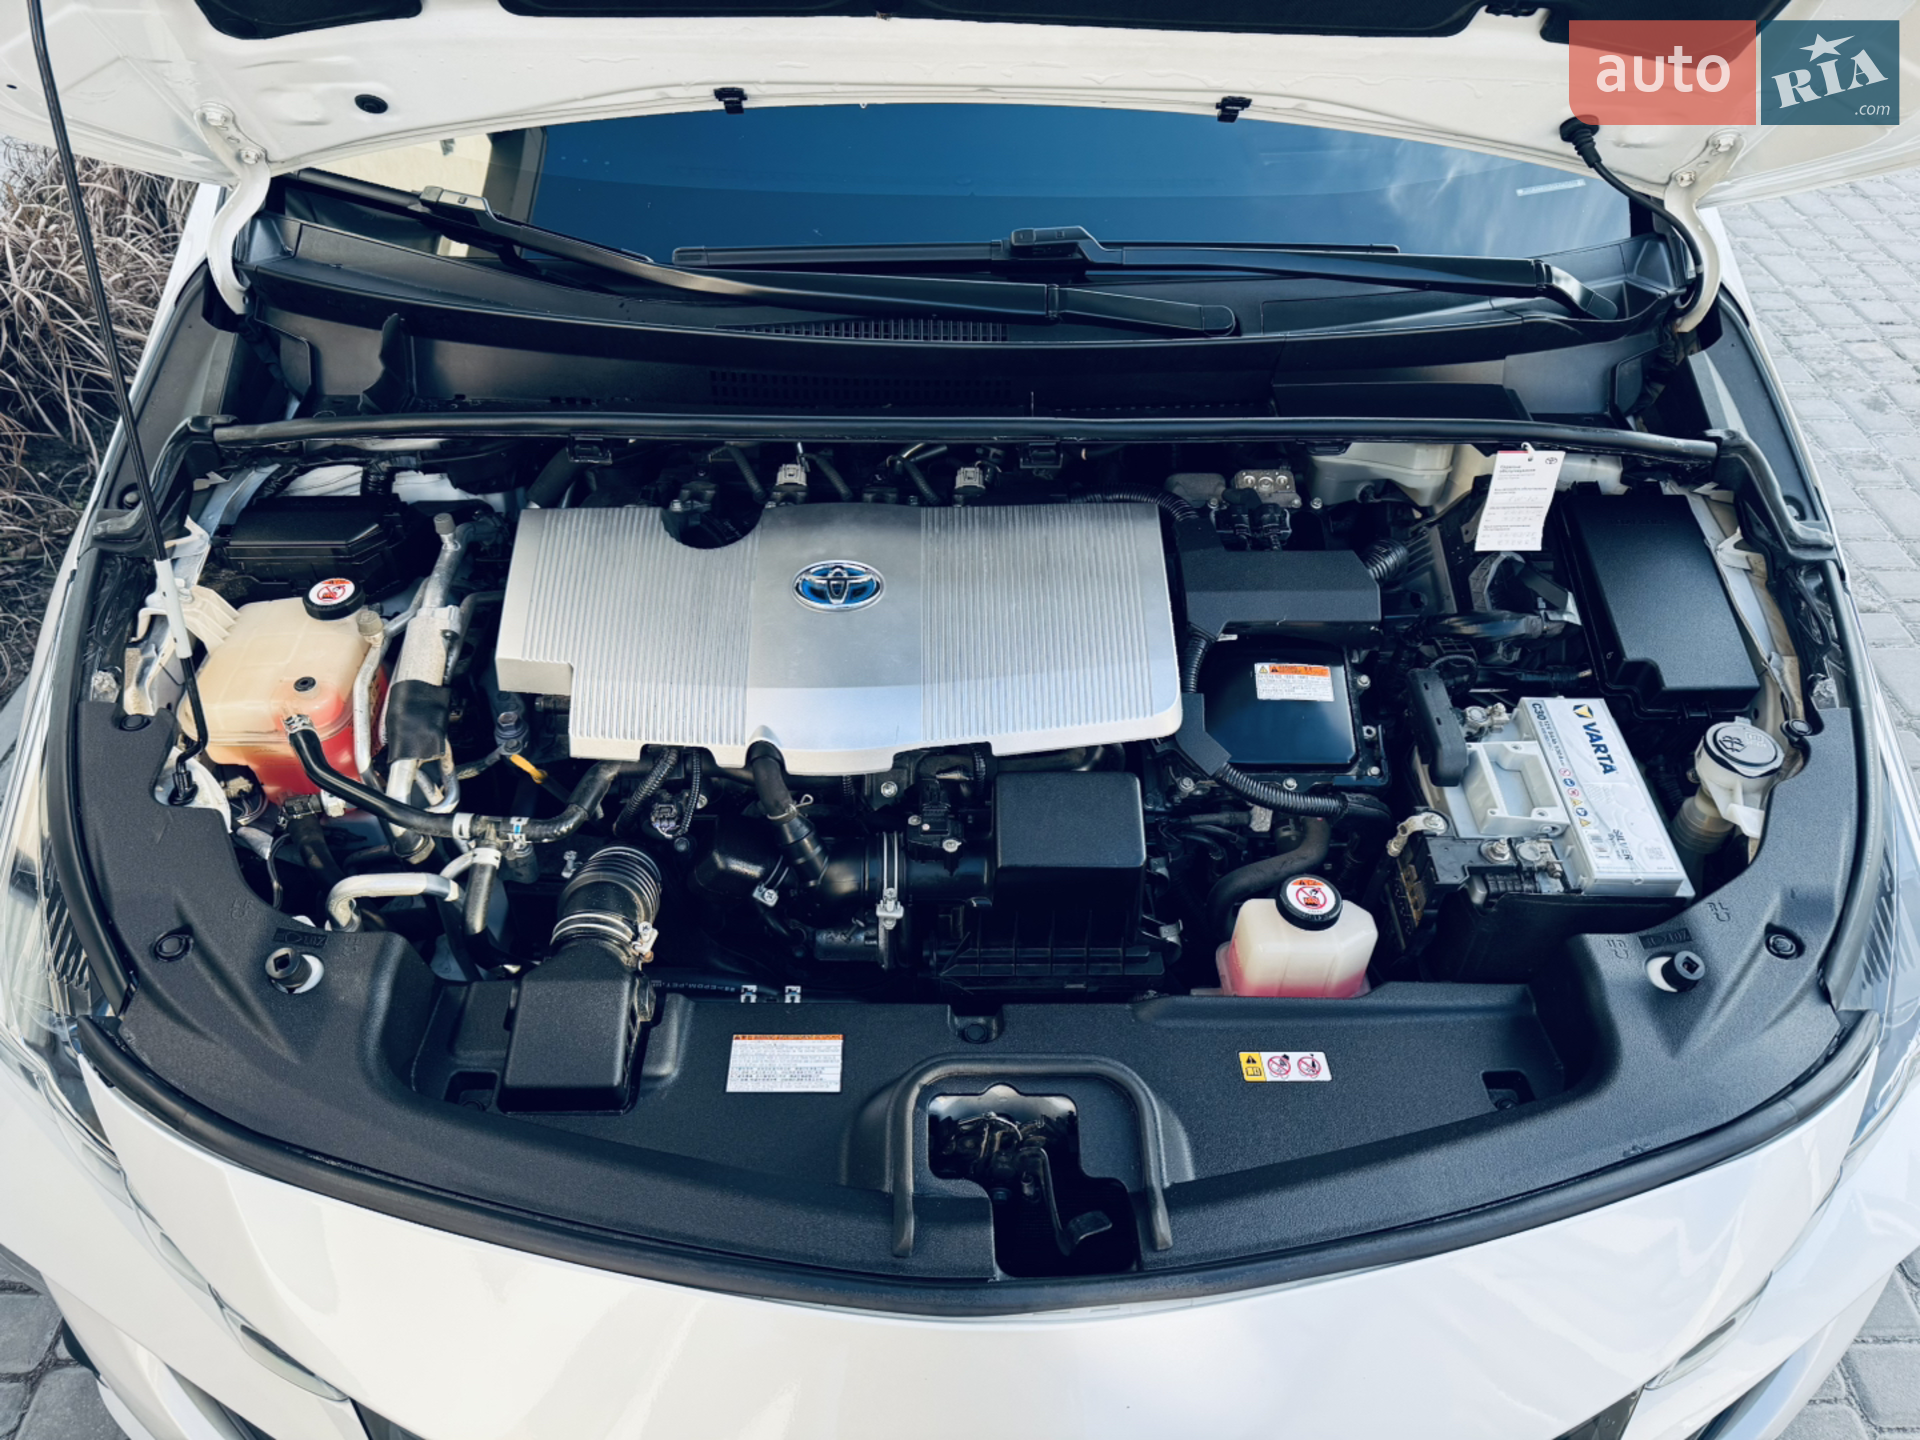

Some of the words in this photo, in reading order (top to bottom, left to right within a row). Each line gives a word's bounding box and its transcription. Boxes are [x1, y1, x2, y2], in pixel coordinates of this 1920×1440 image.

[1531, 703, 1547, 721] C30
[1582, 721, 1617, 775] VARTA
[1612, 828, 1633, 861] SILVER
